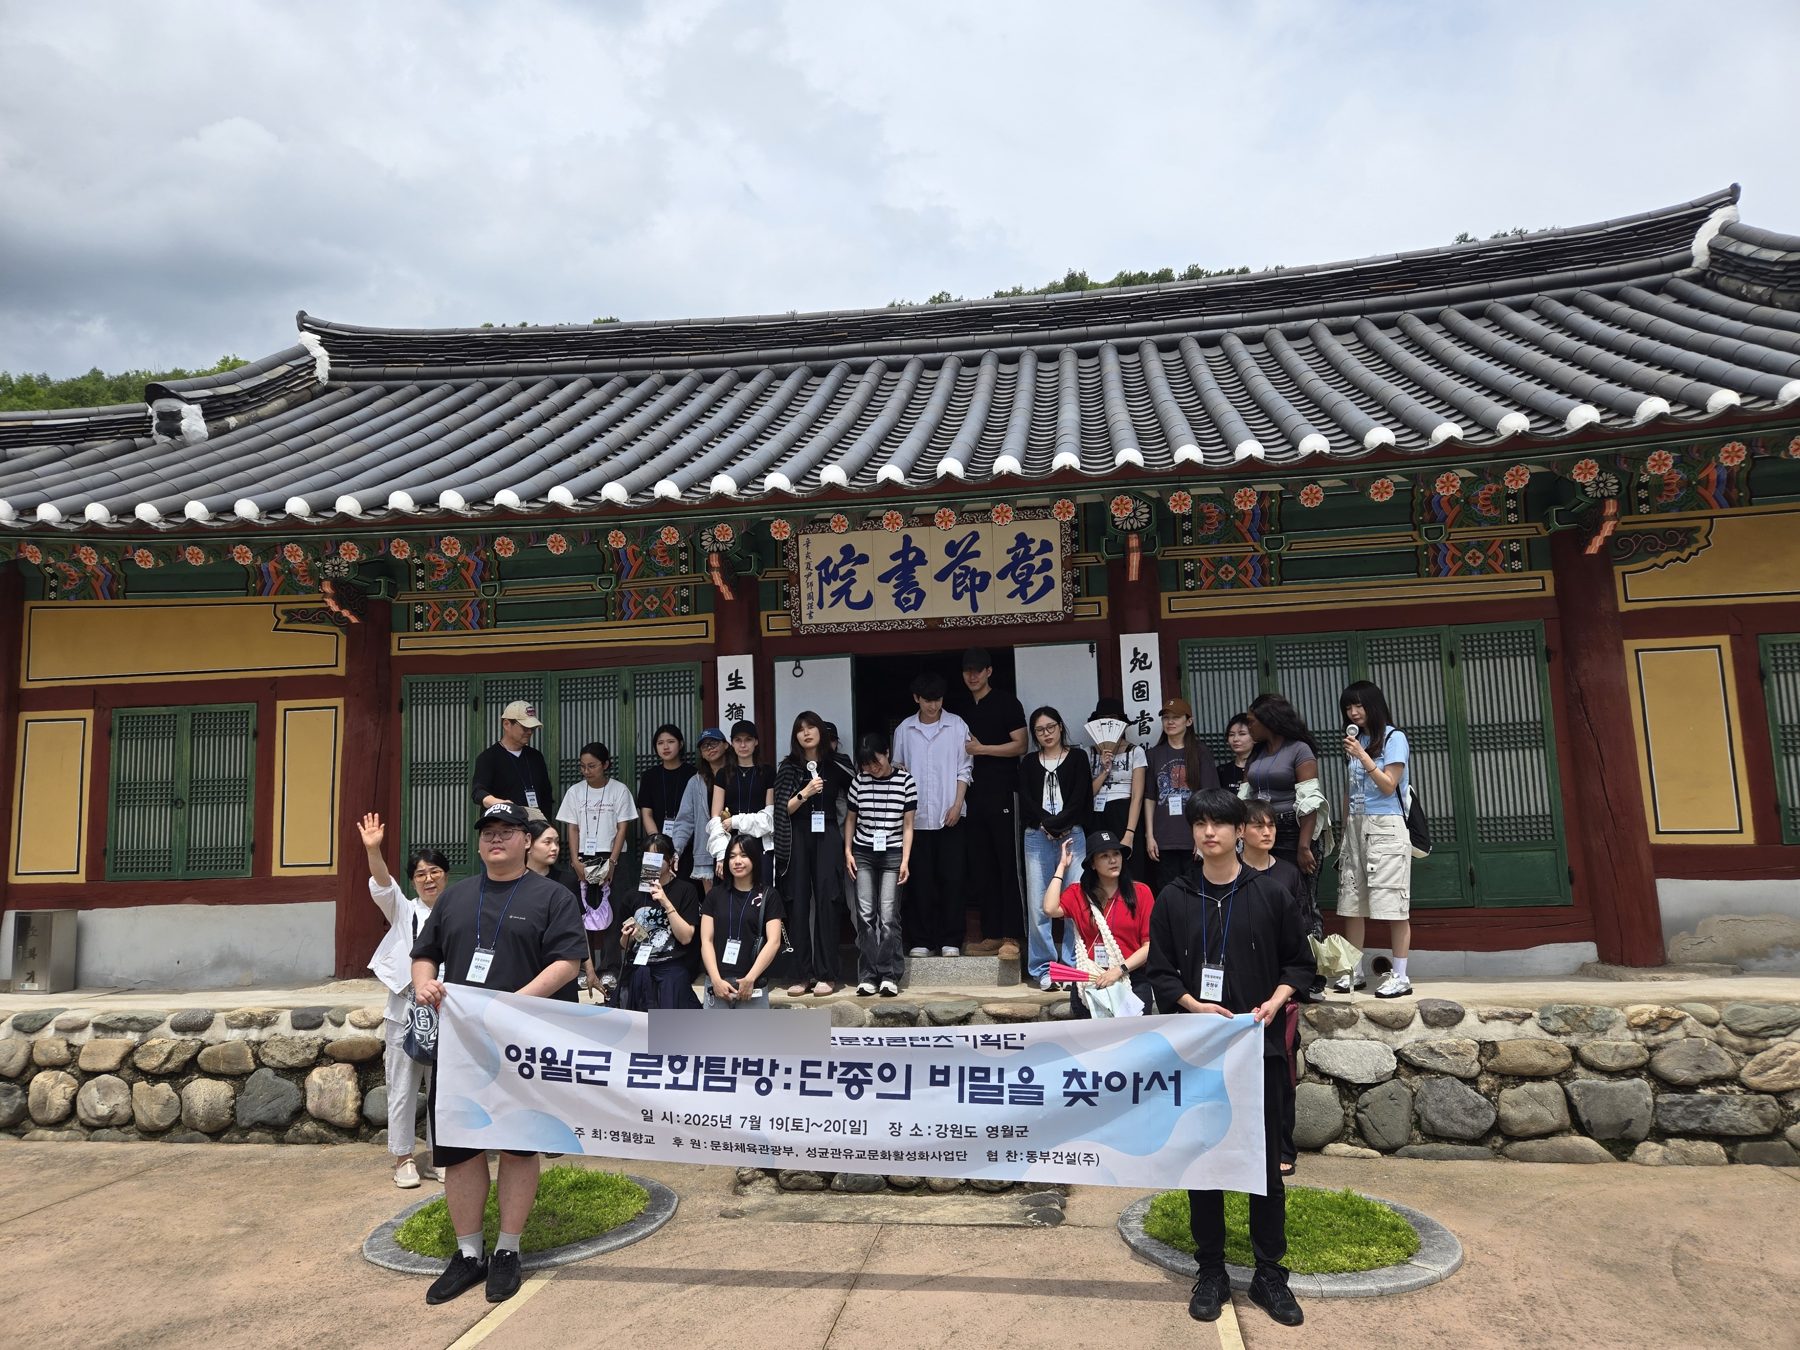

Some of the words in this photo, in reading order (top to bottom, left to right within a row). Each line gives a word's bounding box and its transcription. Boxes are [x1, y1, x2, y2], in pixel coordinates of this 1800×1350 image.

[505, 1044, 612, 1087] 영월군
[930, 1065, 1044, 1106] 비밀을
[1063, 1069, 1181, 1107] 찾아서
[641, 1109, 653, 1122] 일
[740, 1115, 761, 1130] 7월
[888, 1122, 902, 1137] 장
[986, 1125, 1029, 1138] 영월군
[574, 1127, 585, 1138] 주
[672, 1136, 684, 1148] 후
[806, 1146, 968, 1162] 성균관유교문화활성화사업단
[986, 1150, 998, 1162] 협
